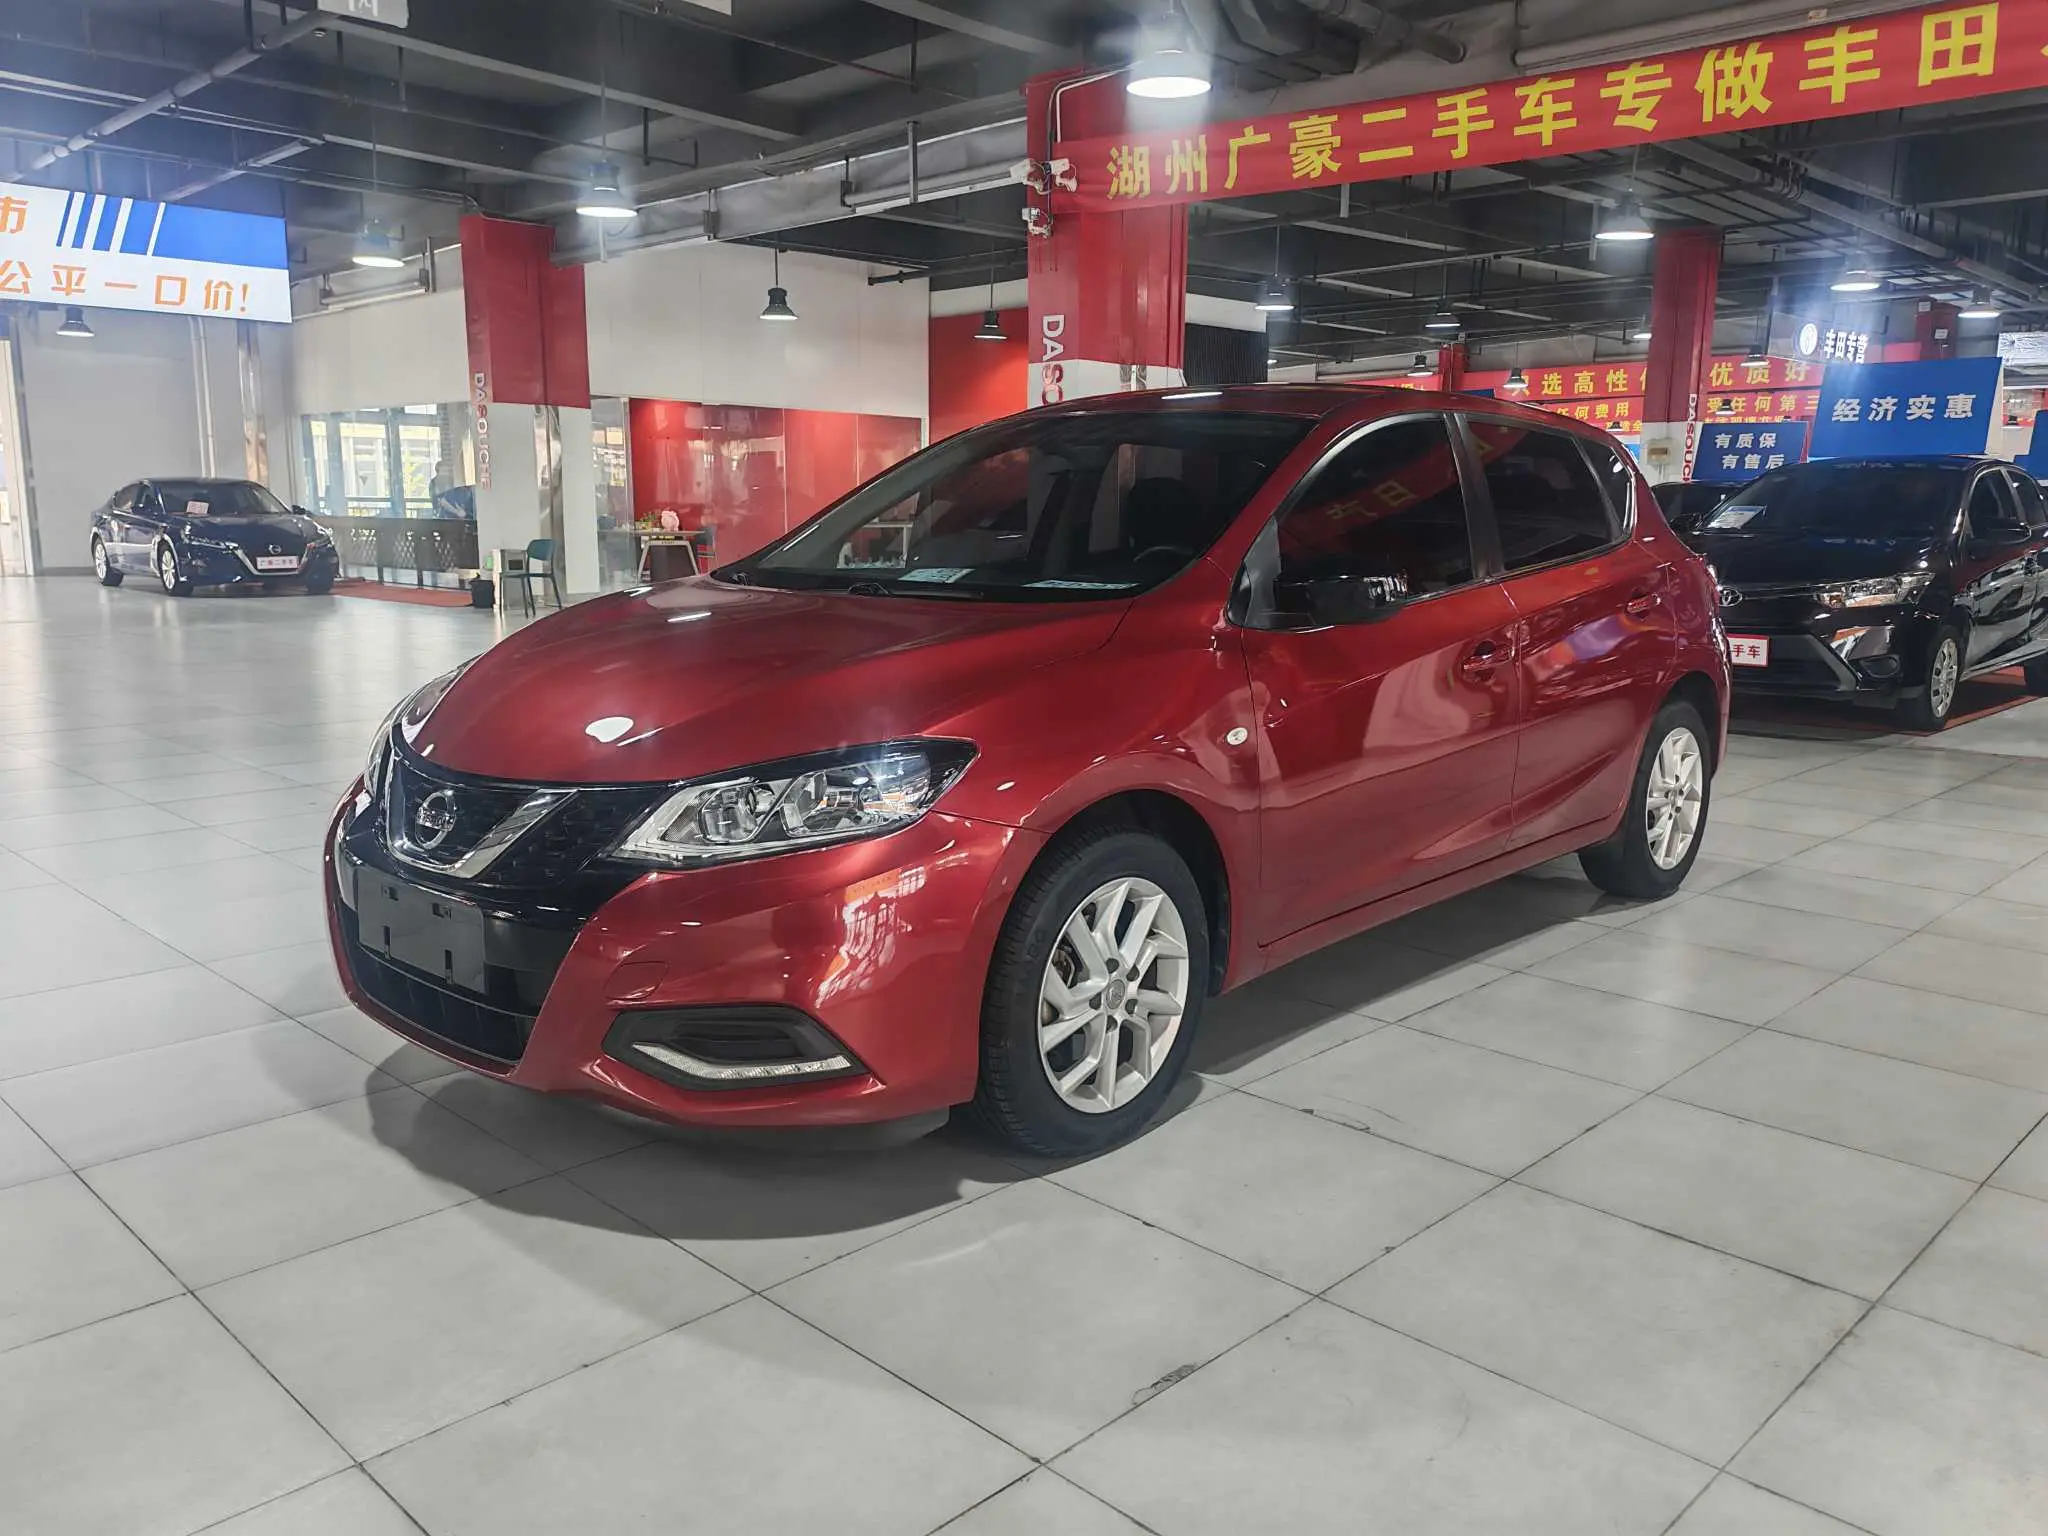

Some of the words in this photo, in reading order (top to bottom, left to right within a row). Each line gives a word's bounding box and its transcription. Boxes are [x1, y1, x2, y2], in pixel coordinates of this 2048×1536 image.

[1107, 2, 2048, 200] 湖州广豪二手车专做丰田
[0, 196, 29, 234] 市
[0, 259, 249, 312] 公平一口价!
[1832, 393, 1977, 422] 经济实惠
[1714, 432, 1777, 449] 有质保
[1721, 454, 1785, 470] 有售后
[1731, 643, 1761, 659] 手车
